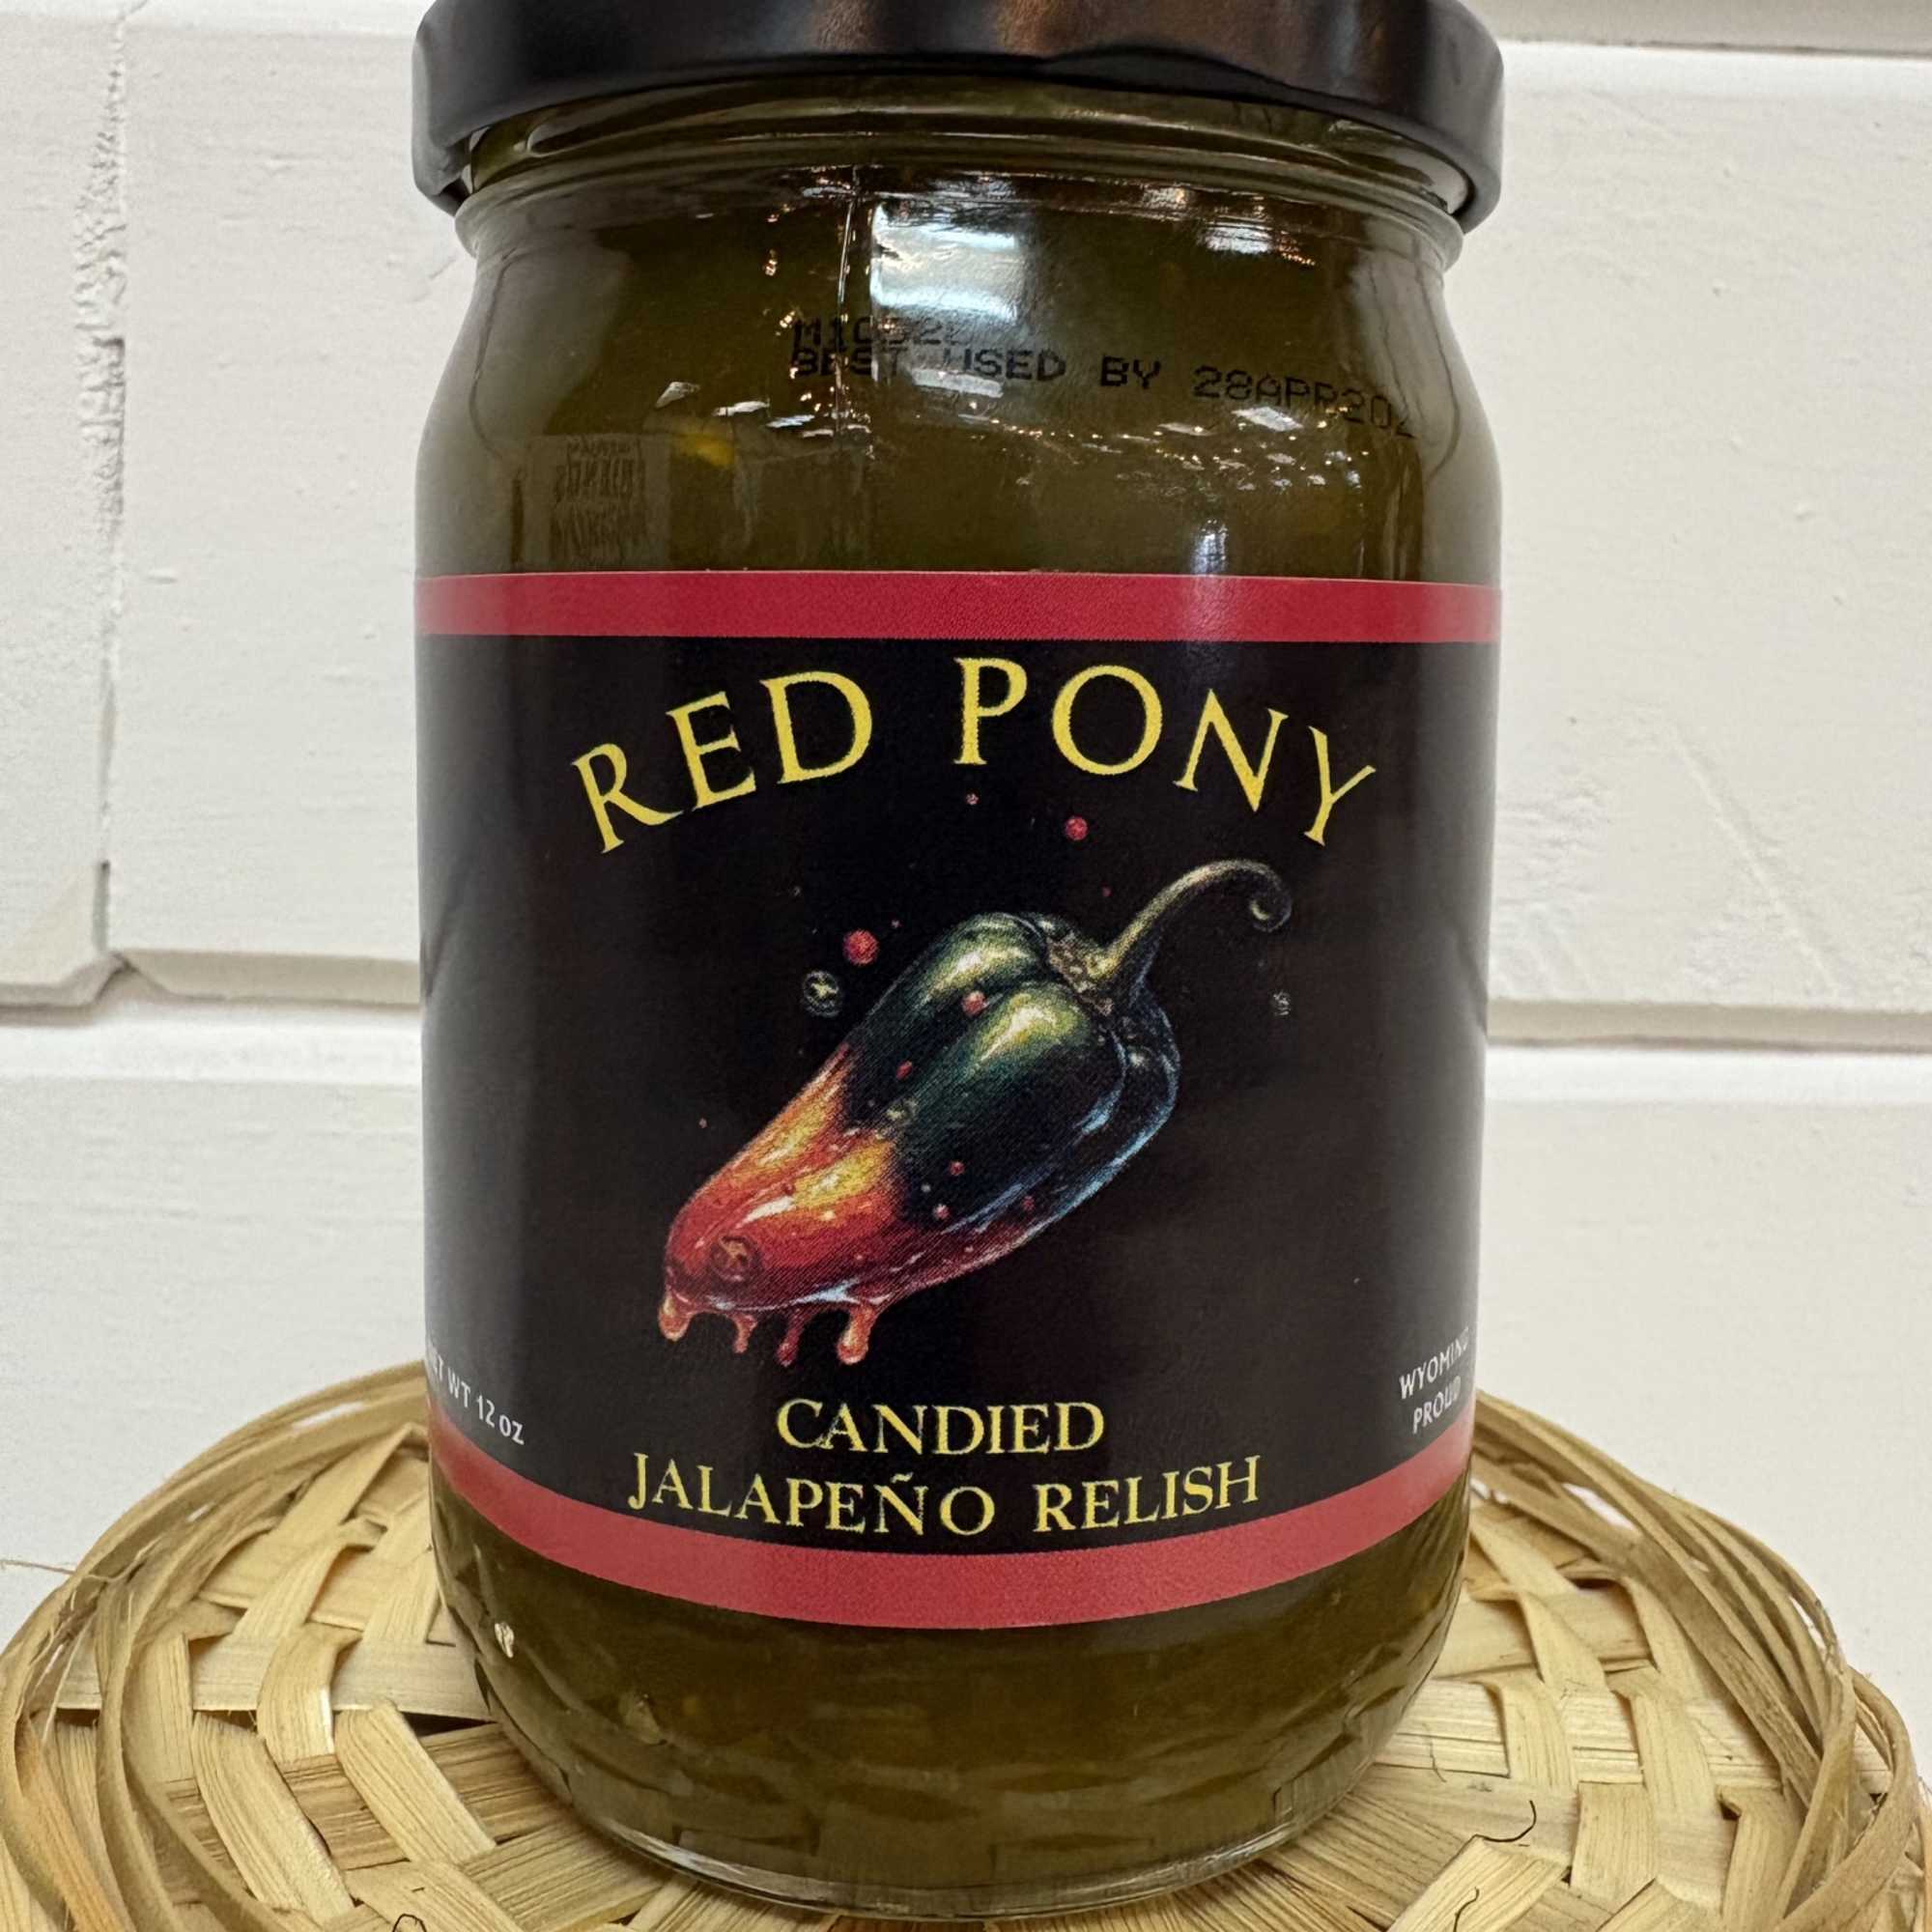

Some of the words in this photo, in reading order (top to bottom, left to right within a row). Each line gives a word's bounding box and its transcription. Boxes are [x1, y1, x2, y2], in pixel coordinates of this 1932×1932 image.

[941, 347, 1066, 382] USED
[1100, 355, 1161, 390] BY
[572, 670, 874, 854] RED
[953, 656, 1377, 847] PONY
[447, 1366, 472, 1408] WT
[476, 1394, 496, 1429] 12
[498, 1413, 526, 1446] OZ
[776, 1398, 1105, 1456] CANDIED
[627, 1452, 997, 1537] JALAPEÑO
[1033, 1455, 1261, 1533] RELISH
